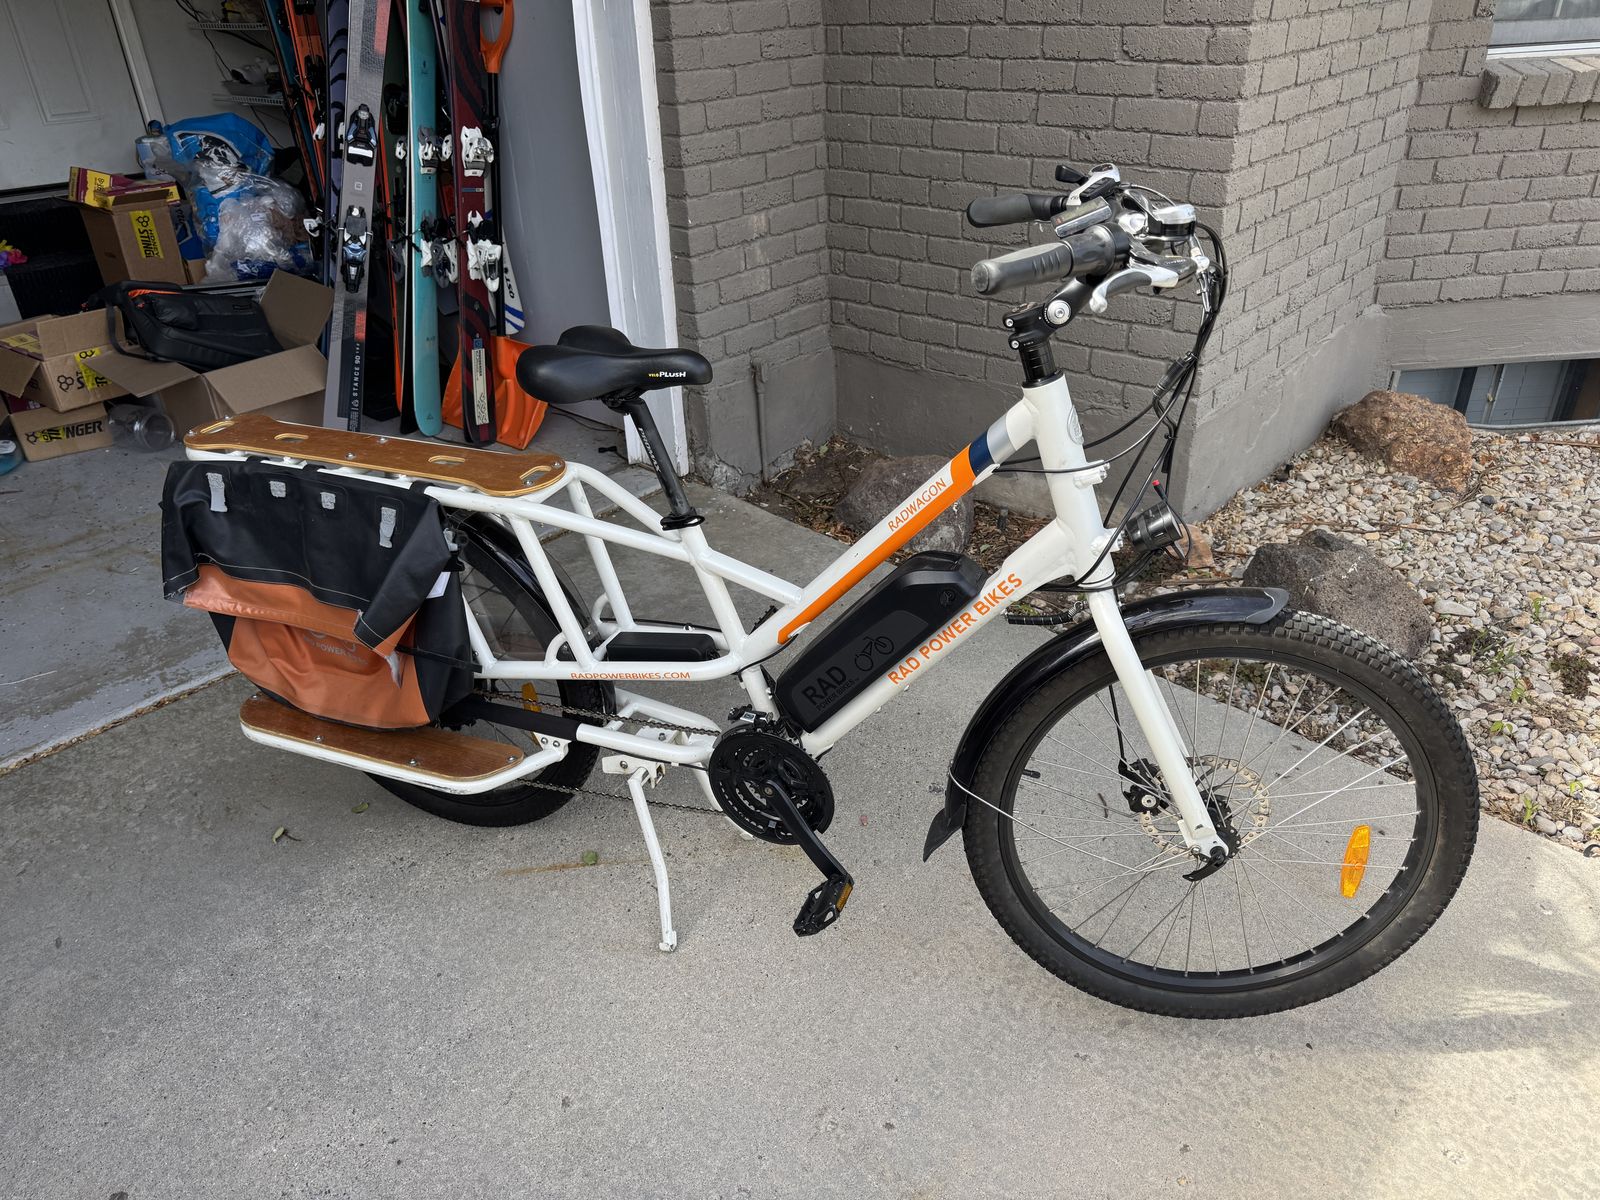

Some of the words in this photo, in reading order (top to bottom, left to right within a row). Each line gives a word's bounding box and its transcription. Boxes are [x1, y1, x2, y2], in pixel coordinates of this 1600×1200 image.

[354, 355, 361, 365] 90
[352, 366, 360, 397] STANCE
[638, 427, 662, 473] PROMAX
[887, 477, 947, 532] RADWAGON
[887, 656, 921, 685] RAD
[919, 612, 978, 659] POWER
[972, 573, 1024, 616] BIKES
[570, 671, 691, 680] RADPOWERBIKES.COM
[801, 666, 847, 706] RAD
